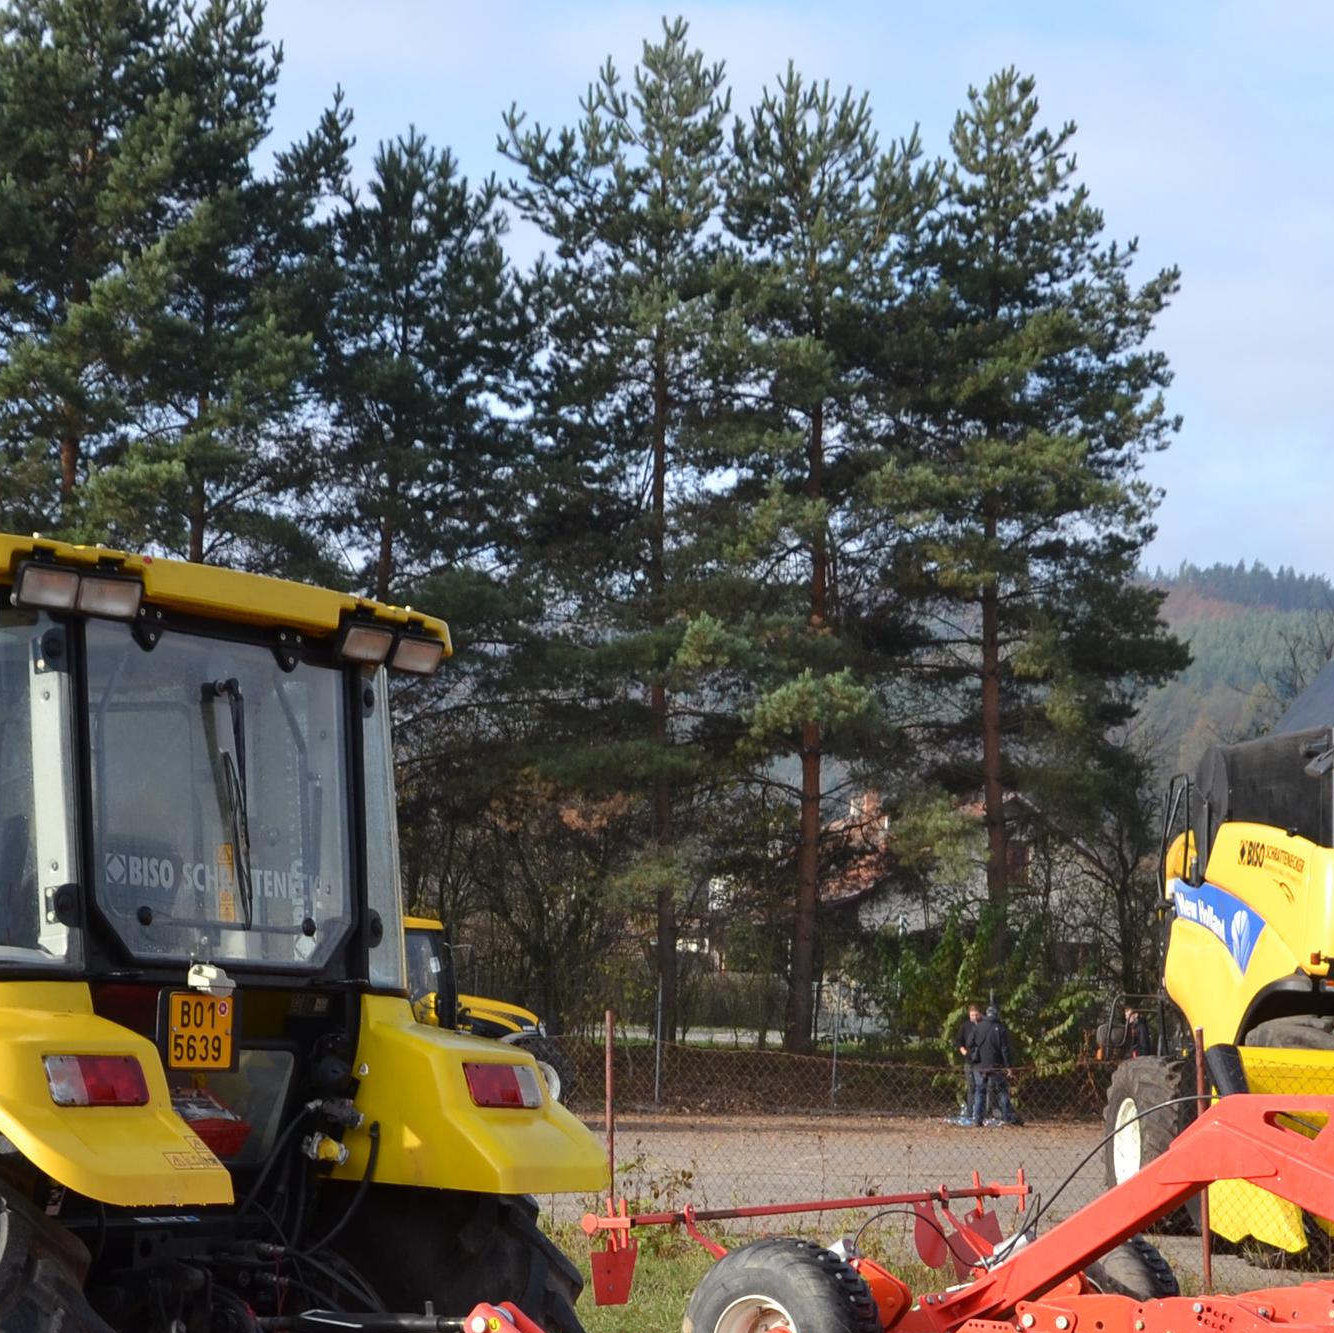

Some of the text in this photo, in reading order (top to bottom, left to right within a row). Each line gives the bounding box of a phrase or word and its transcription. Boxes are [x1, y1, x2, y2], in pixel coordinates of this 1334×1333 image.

[1246, 839, 1265, 868] BISO
[128, 856, 175, 889] BISO
[1175, 891, 1226, 944] New Holland
[174, 1034, 221, 1061] 5639
